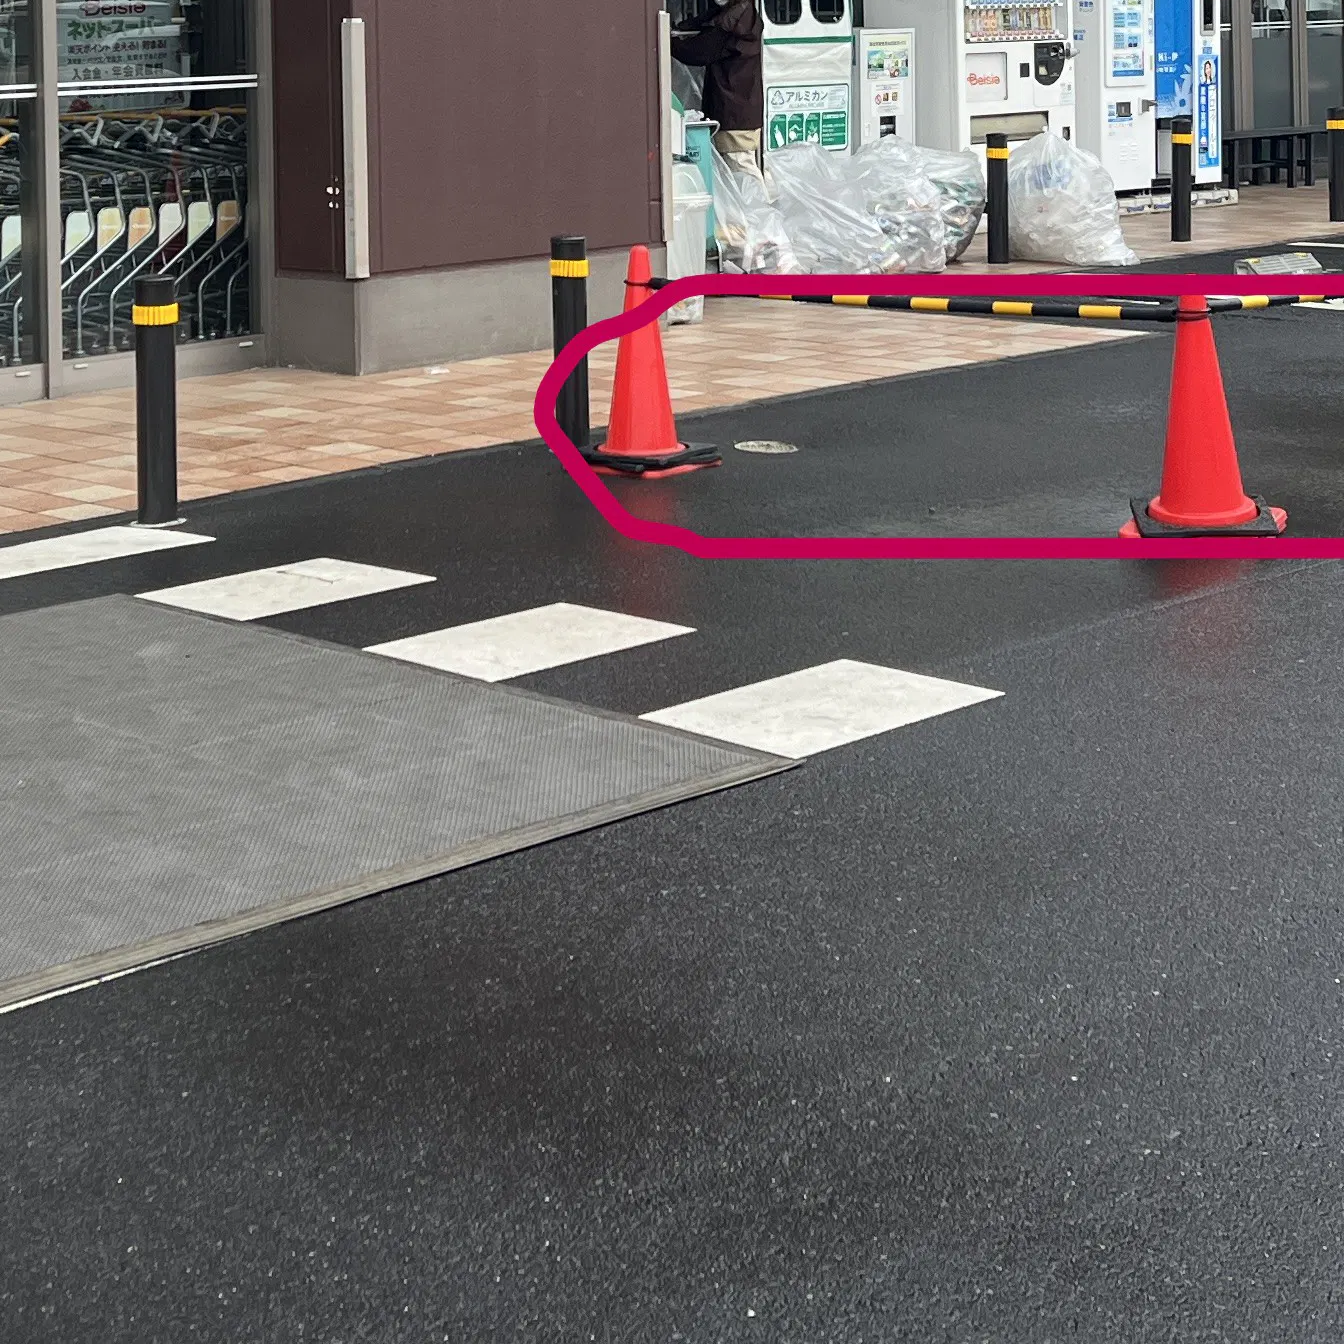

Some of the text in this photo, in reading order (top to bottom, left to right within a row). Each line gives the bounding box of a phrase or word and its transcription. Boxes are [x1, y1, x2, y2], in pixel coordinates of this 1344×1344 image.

[784, 90, 829, 103] アルミカン
